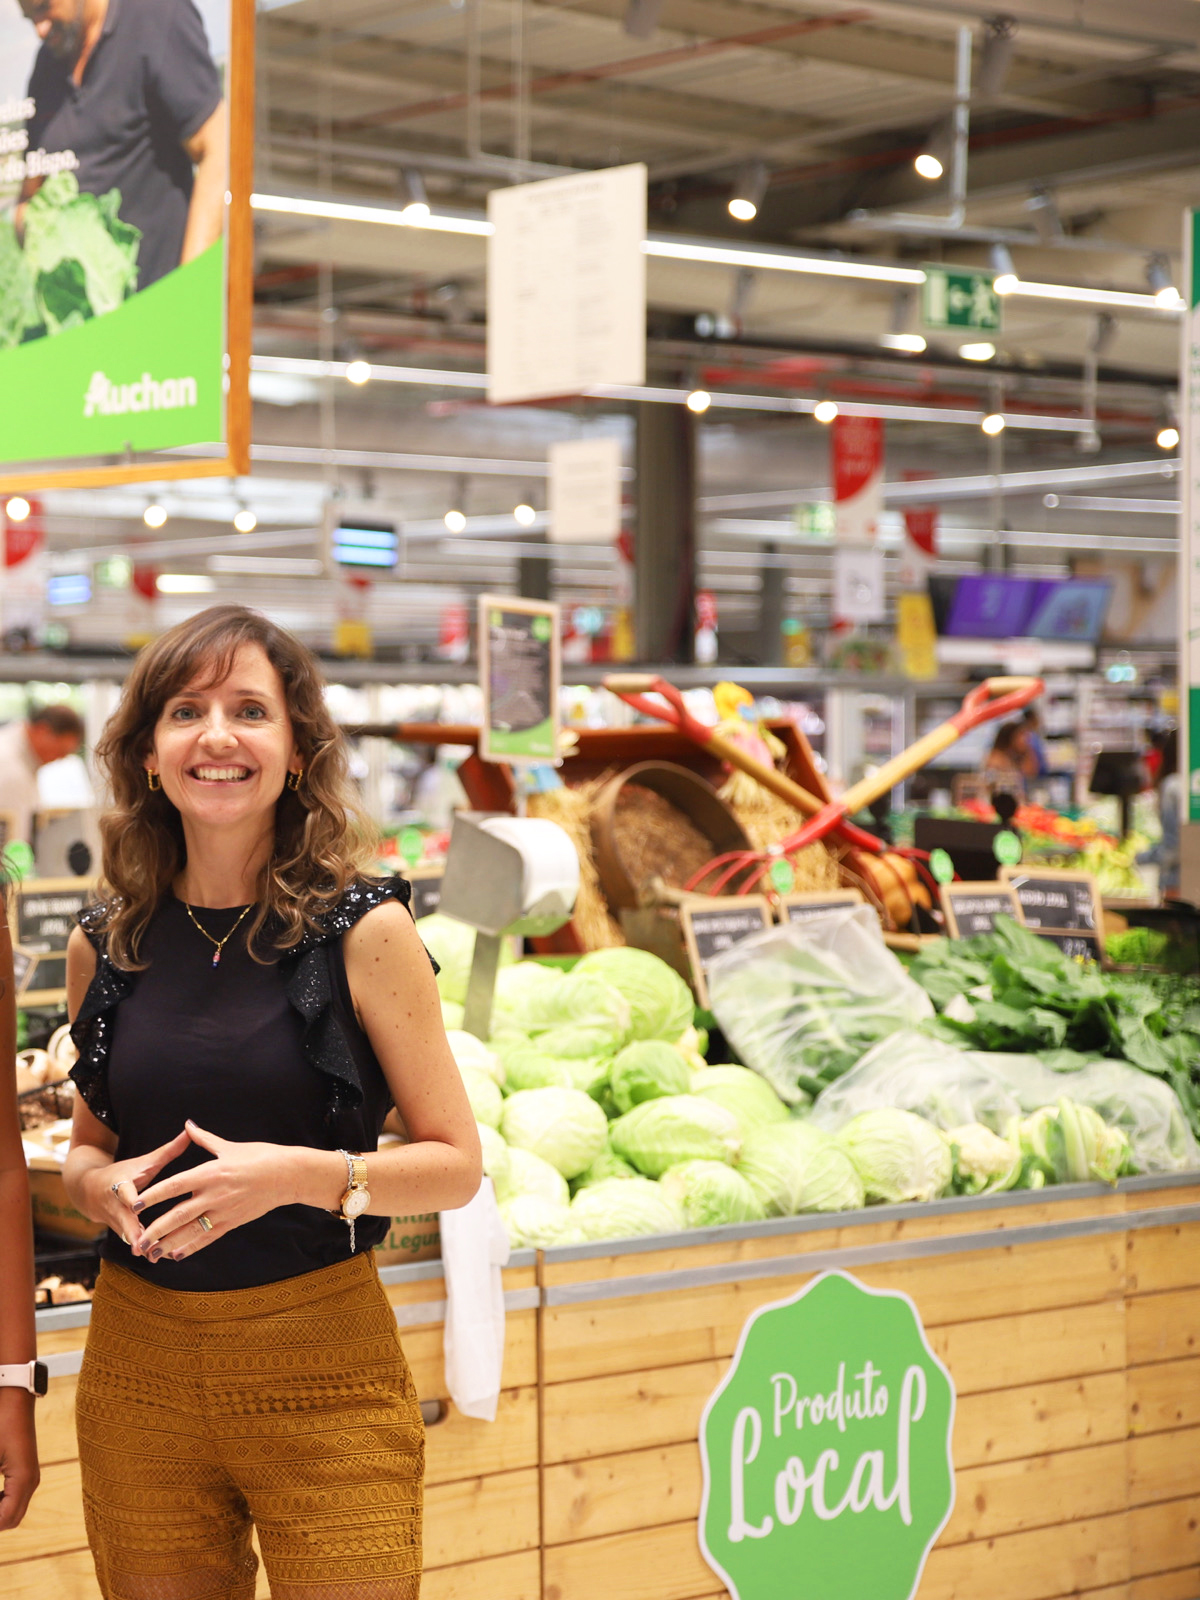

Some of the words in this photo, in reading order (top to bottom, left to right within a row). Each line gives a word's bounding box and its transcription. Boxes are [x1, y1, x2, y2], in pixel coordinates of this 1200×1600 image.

[84, 371, 197, 417] Auchan
[770, 1361, 888, 1437] Produto
[728, 1365, 927, 1542] Local
